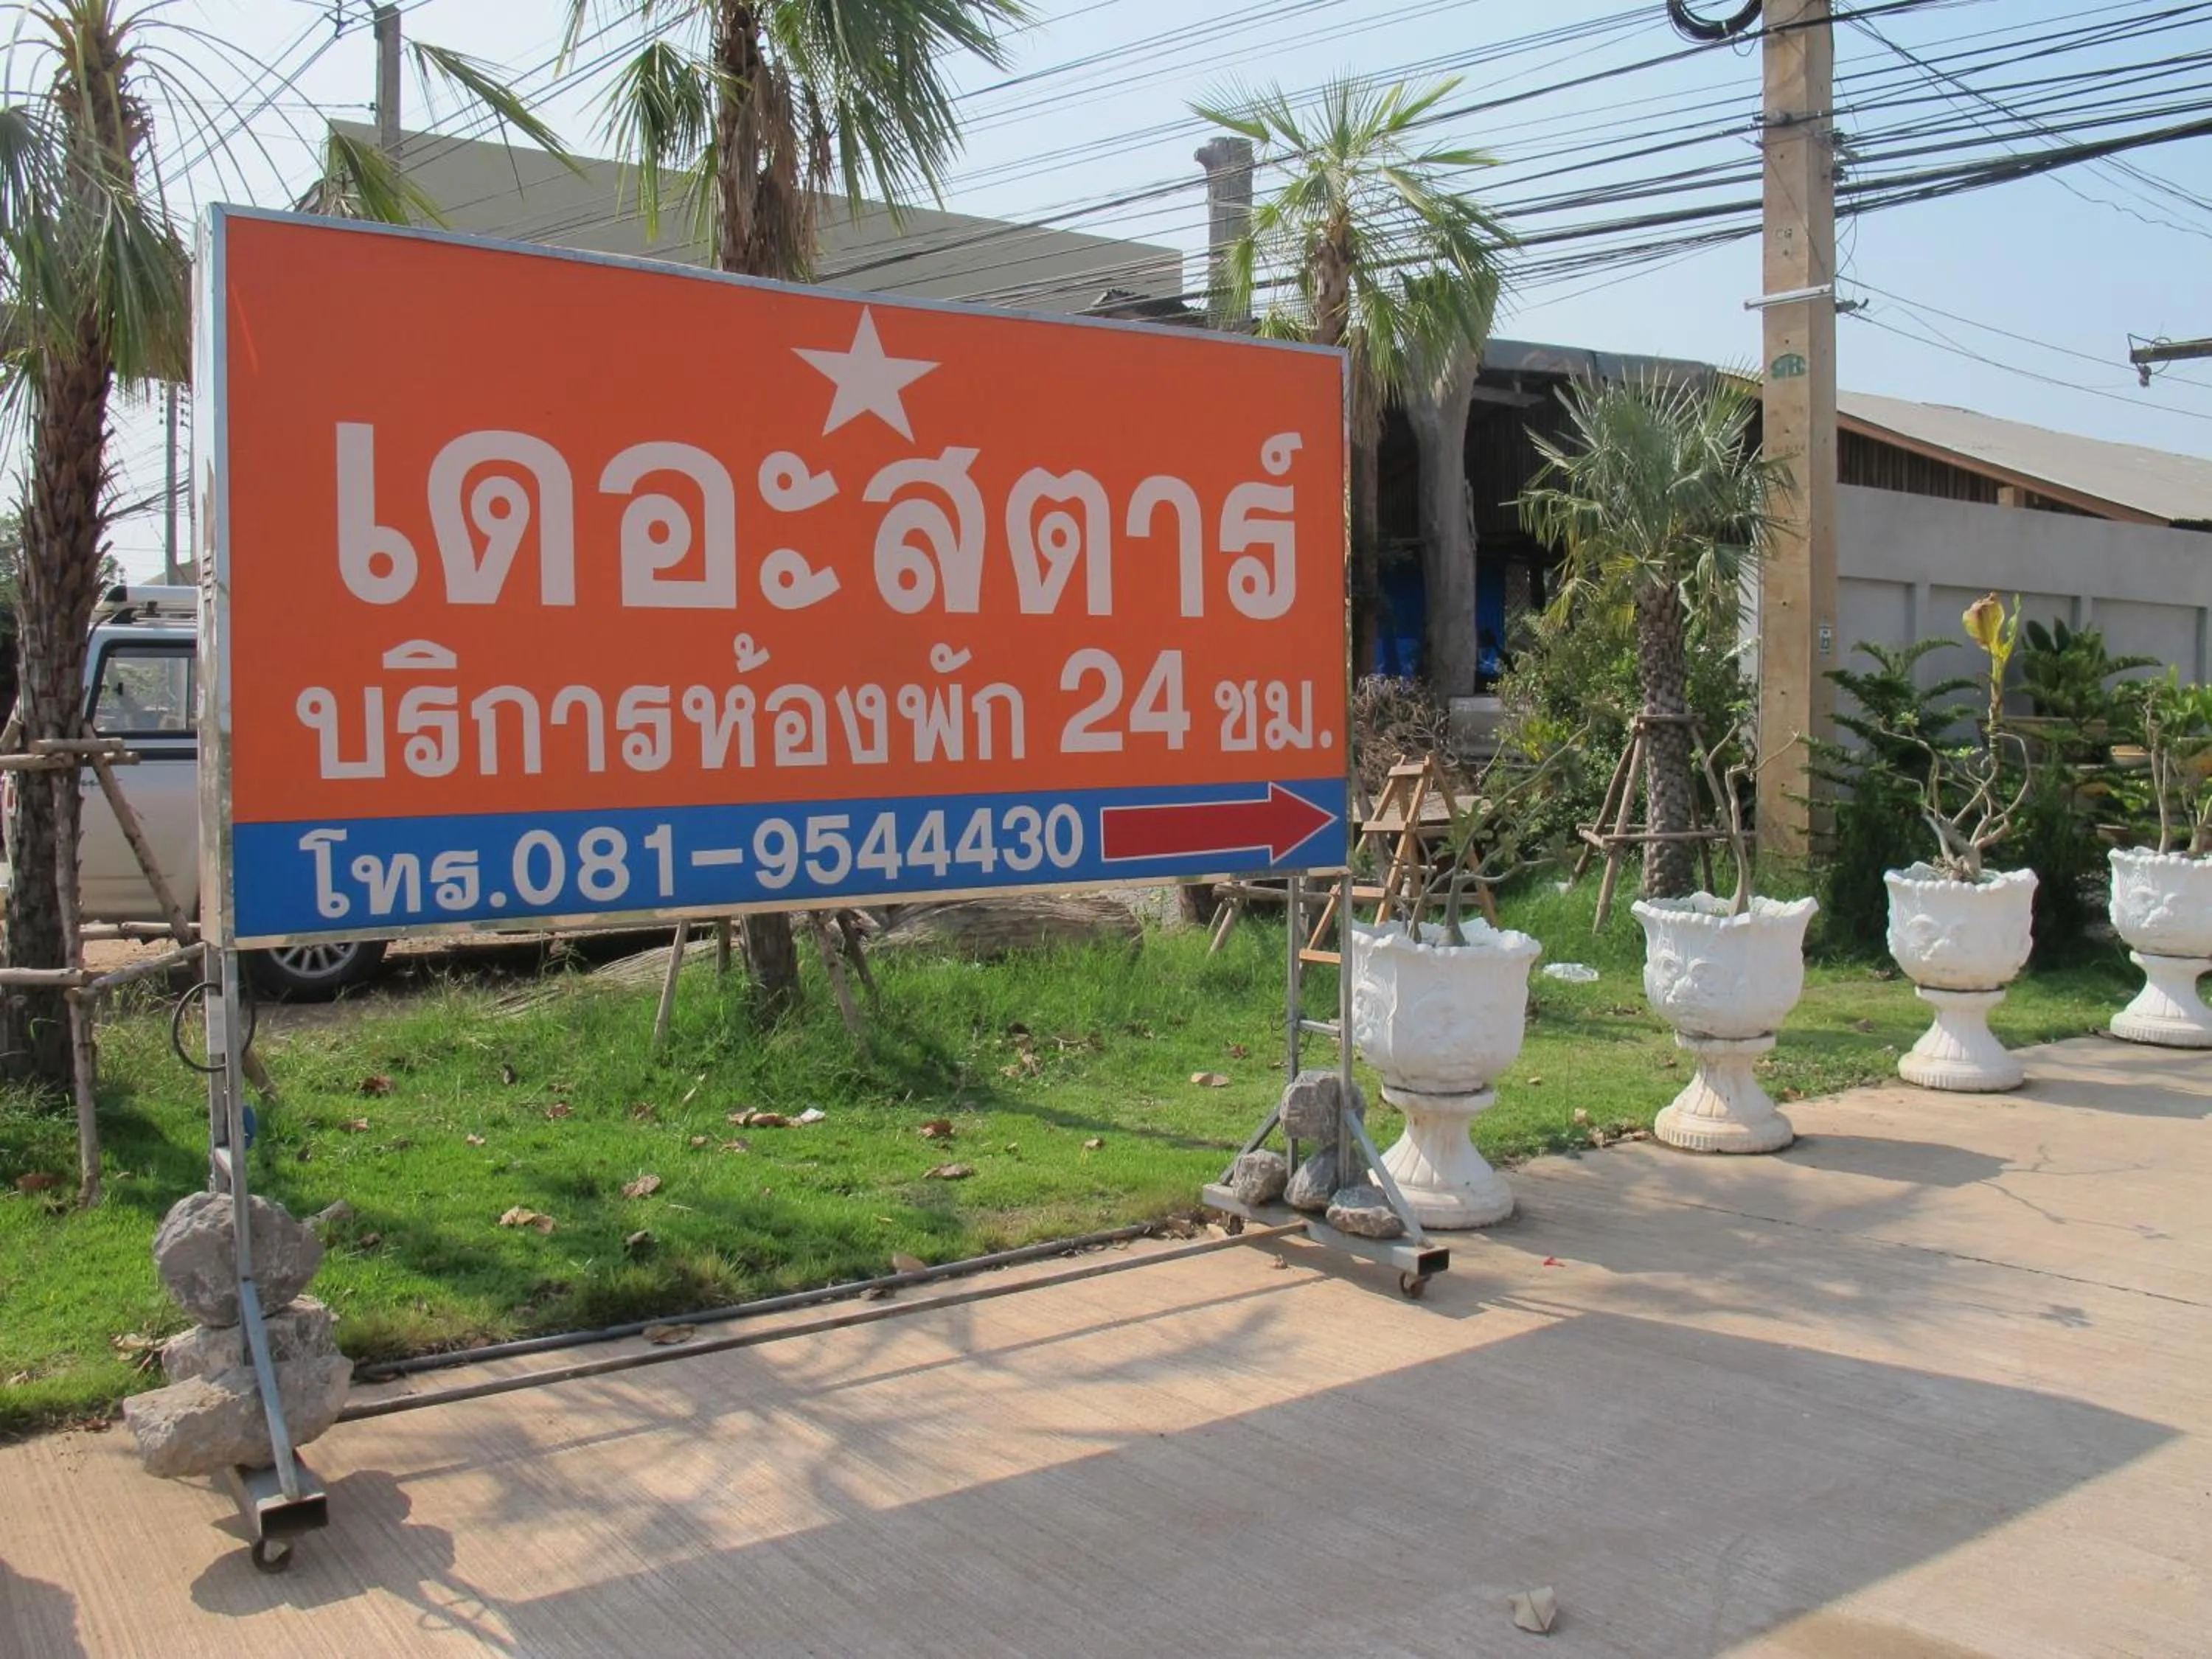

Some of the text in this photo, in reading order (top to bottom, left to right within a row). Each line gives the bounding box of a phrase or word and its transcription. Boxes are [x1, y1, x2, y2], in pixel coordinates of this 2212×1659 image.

[336, 421, 1303, 620] เดอะสตาร์
[296, 633, 1332, 779] บริการห้องพัก 24 ชม.
